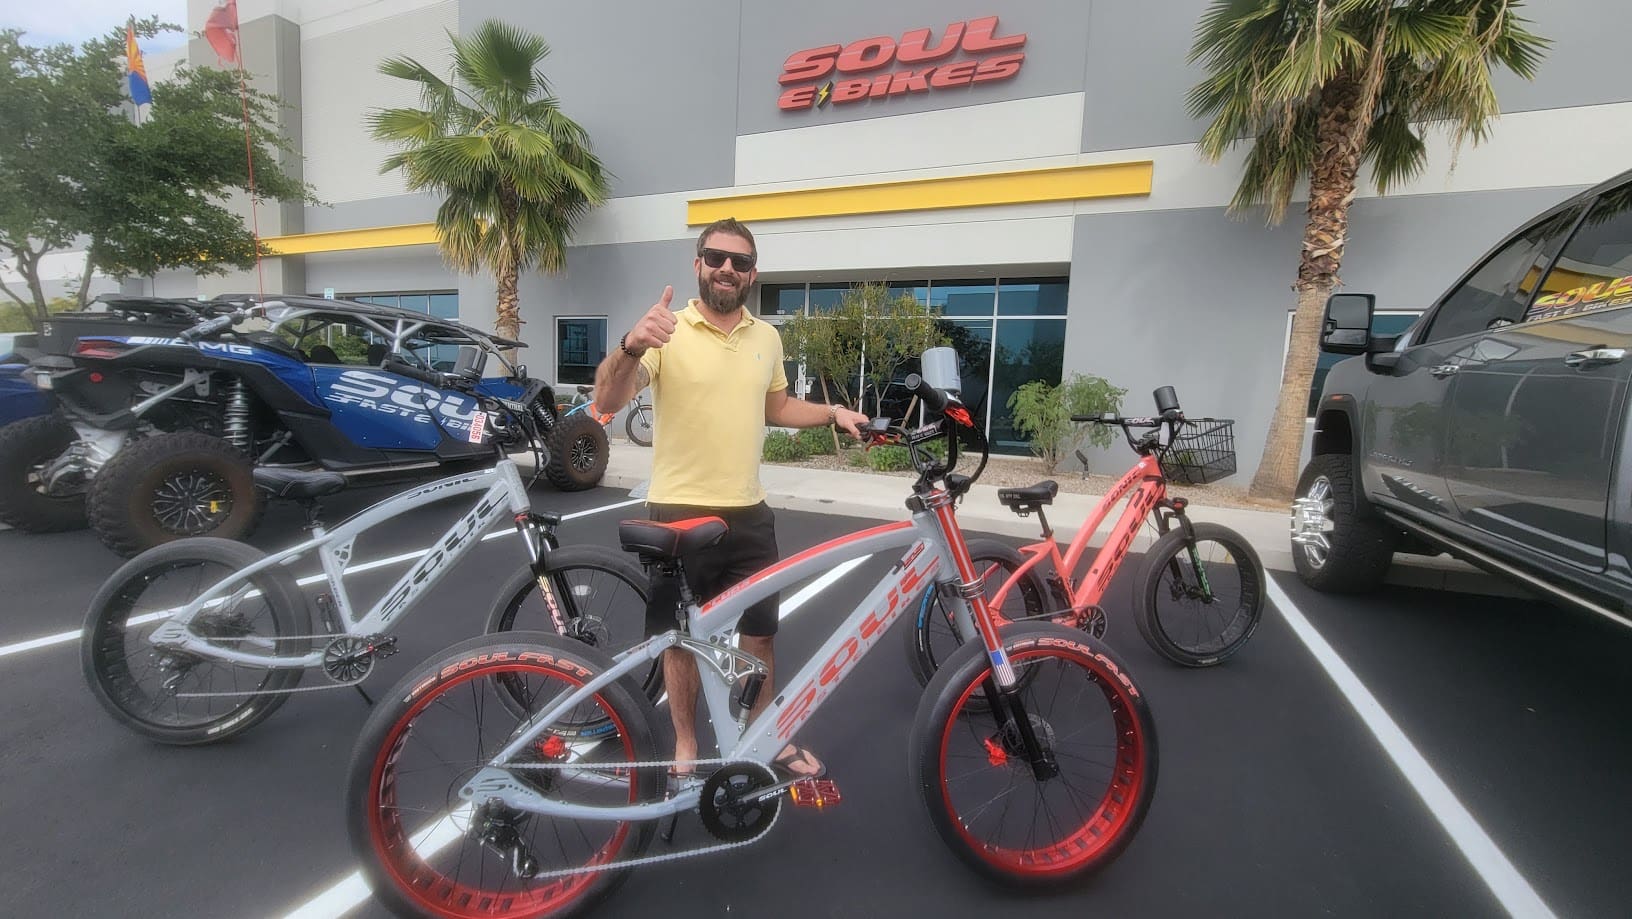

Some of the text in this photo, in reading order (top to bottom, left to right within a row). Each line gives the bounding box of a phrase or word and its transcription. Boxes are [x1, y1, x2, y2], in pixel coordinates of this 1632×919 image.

[778, 15, 1027, 86] SOUL
[831, 52, 1025, 105] BIKES
[380, 491, 509, 621] SOUL
[1096, 486, 1162, 592] SOUL
[440, 652, 593, 679] SOUL FAST
[775, 555, 939, 740] SOUL
[1037, 637, 1140, 698] SOUL FAST
[758, 788, 788, 802] SOUL
